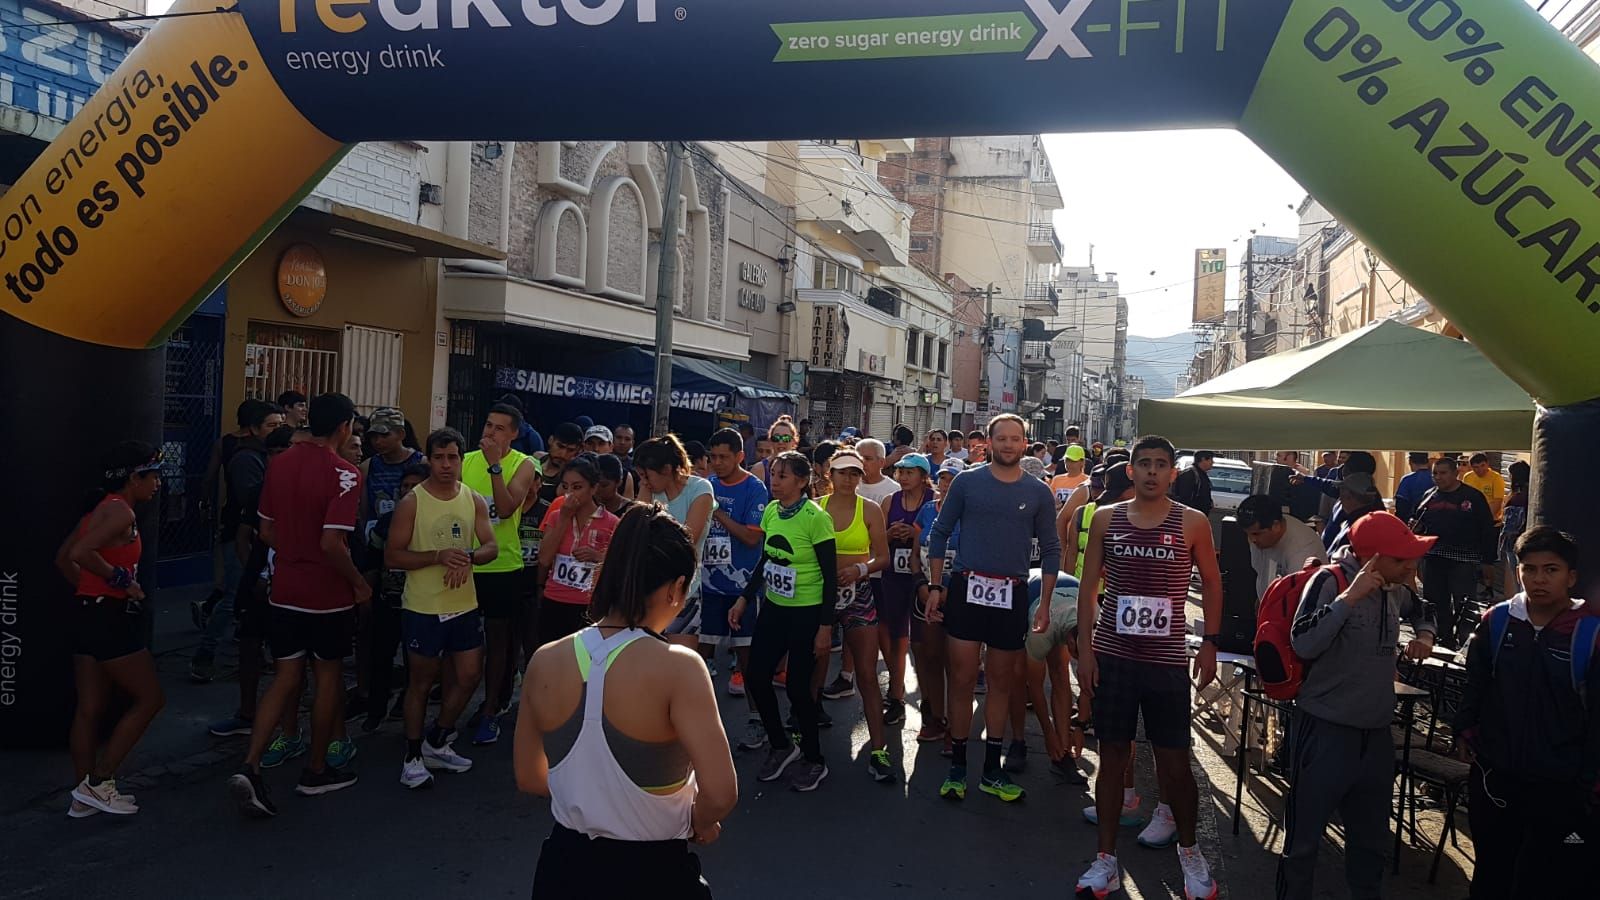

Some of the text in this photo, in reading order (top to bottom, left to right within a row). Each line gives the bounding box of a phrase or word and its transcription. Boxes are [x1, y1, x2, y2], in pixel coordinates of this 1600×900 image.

[788, 23, 1022, 51] zero sugar energy drink
[1303, 7, 1402, 105] 0%
[286, 43, 446, 76] energy drink
[45, 69, 165, 195] energía,
[1500, 76, 1600, 199] ENE
[4, 225, 79, 304] todo
[77, 179, 120, 229] es
[115, 53, 249, 198] posible.
[287, 274, 310, 288] DON
[812, 305, 823, 367] TATTOO
[823, 306, 834, 368] PIERCING
[515, 369, 726, 413] SAMEC SAMEC SAMEC
[557, 562, 592, 584] 067
[1113, 544, 1175, 561] CANADA
[971, 583, 1008, 603] 061
[0, 571, 21, 706] energy drink
[1121, 605, 1168, 630] 086
